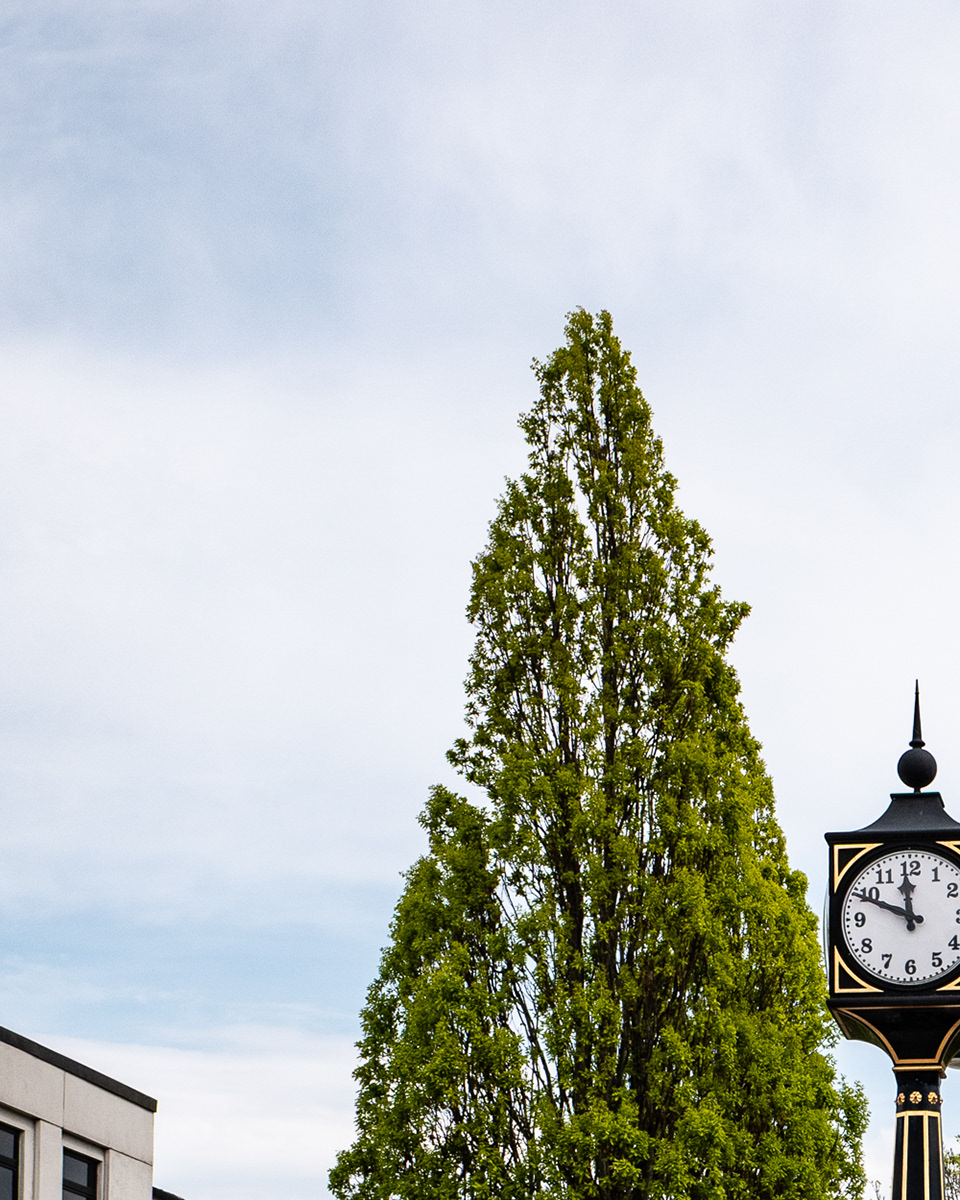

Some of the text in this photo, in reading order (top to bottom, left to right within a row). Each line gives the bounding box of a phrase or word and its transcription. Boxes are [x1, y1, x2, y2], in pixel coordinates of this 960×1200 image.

[900, 860, 921, 876] 12
[931, 867, 940, 882] 1
[876, 869, 894, 884] 11
[860, 886, 880, 901] 10
[946, 883, 959, 898] 2
[854, 912, 866, 927] 9
[861, 938, 873, 953] 8
[948, 935, 960, 950] 4
[881, 954, 893, 969] 7
[905, 959, 916, 974] 6
[931, 952, 943, 967] 5
